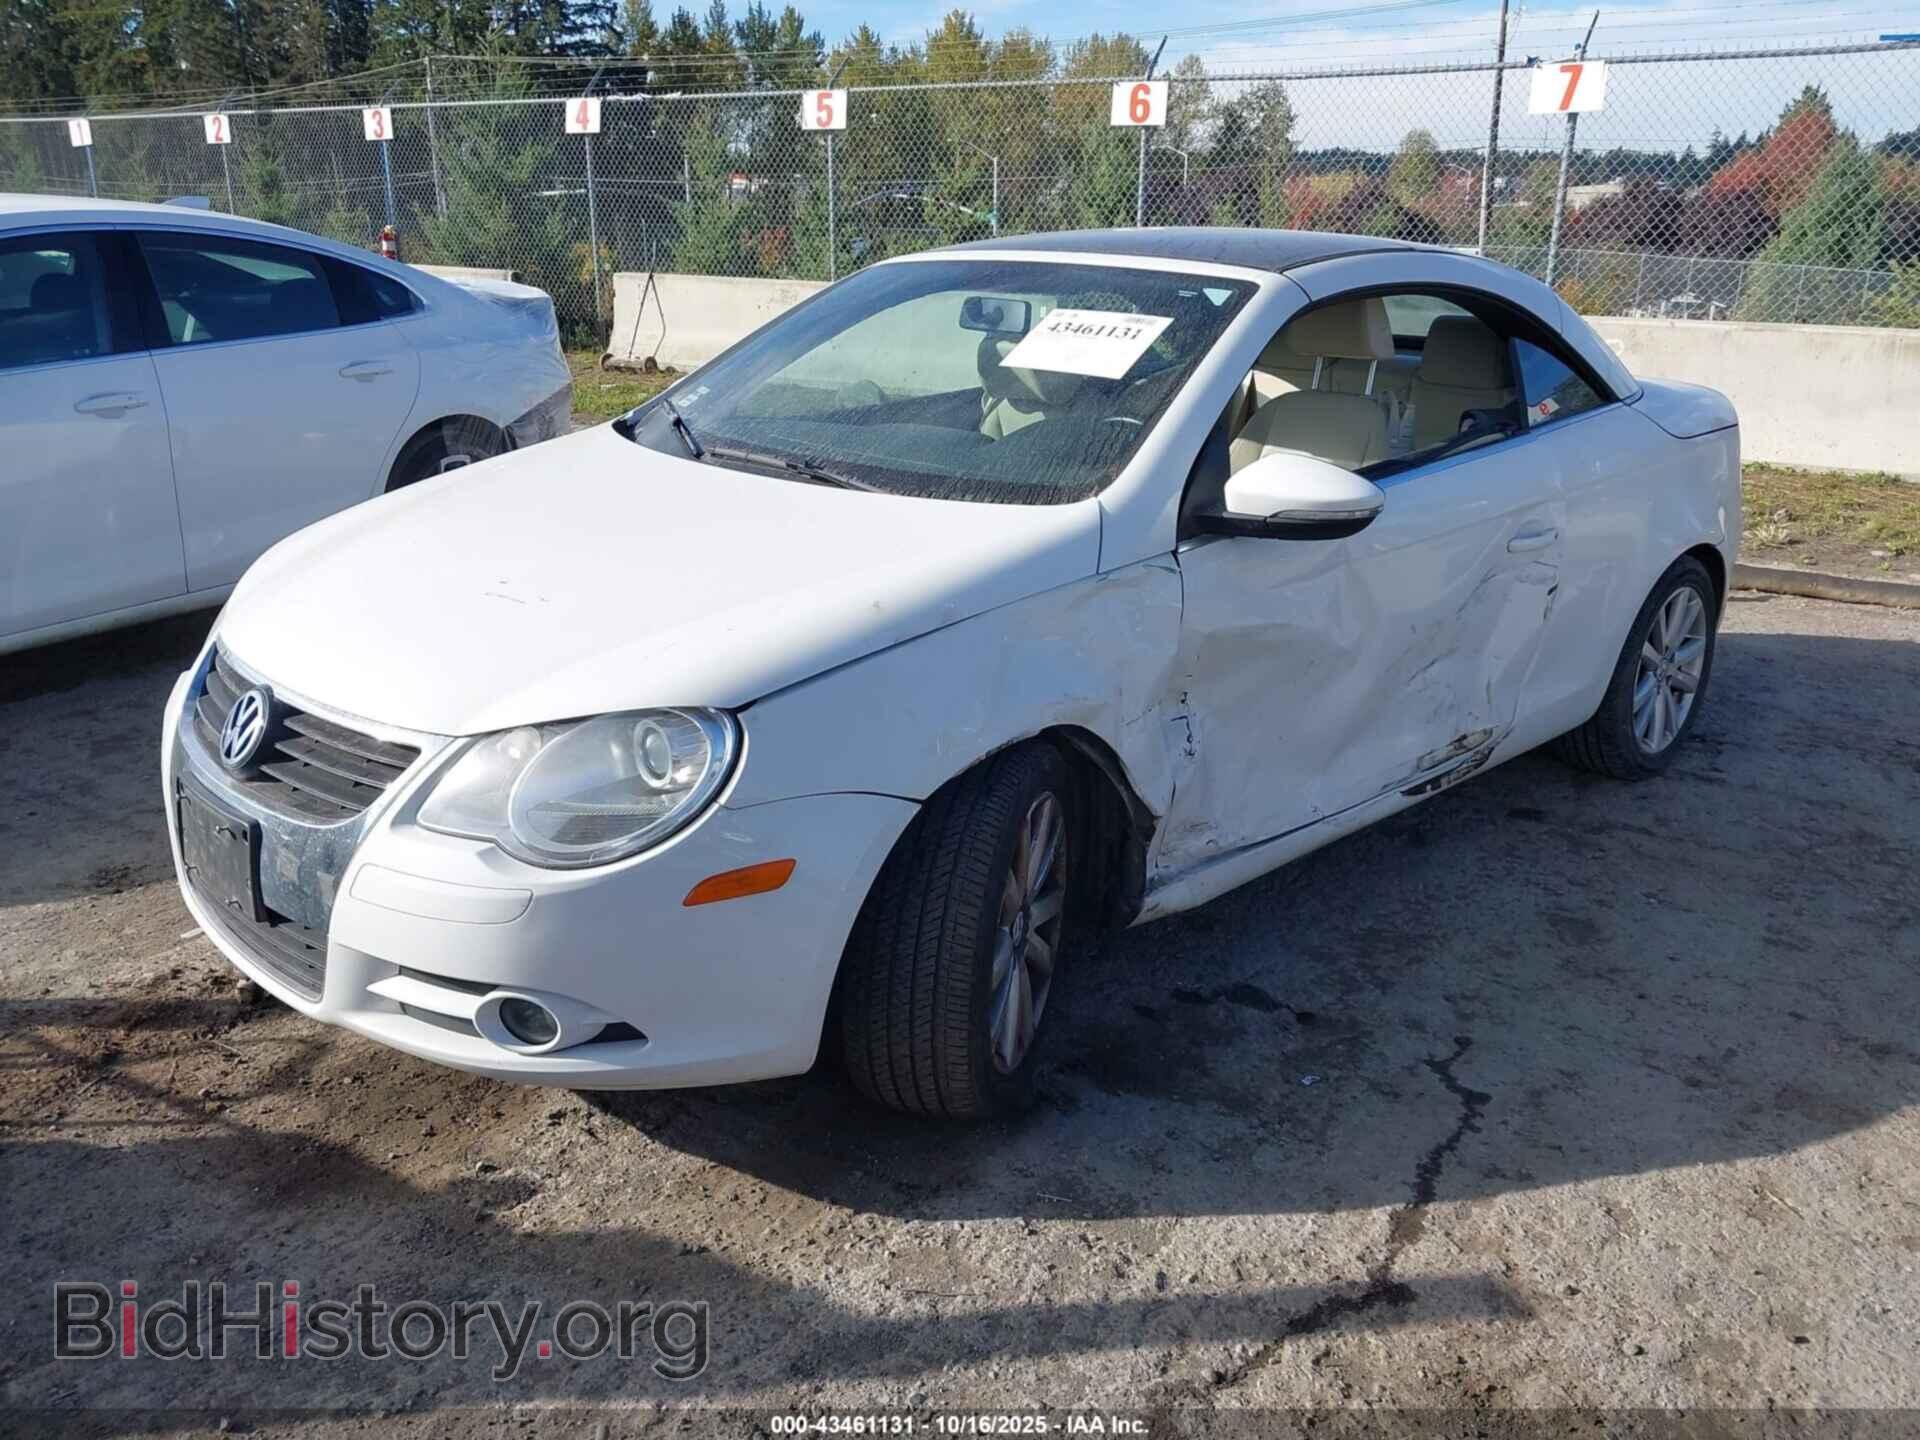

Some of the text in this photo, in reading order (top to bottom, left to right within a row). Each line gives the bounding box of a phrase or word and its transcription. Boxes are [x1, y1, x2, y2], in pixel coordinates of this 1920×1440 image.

[1559, 64, 1584, 111] 7
[575, 100, 590, 131] 4
[816, 91, 833, 128] 5
[1129, 83, 1151, 124] 6
[76, 121, 85, 145] 1
[212, 116, 224, 142] 2
[372, 110, 384, 138] 3
[1048, 321, 1143, 340] 43461131
